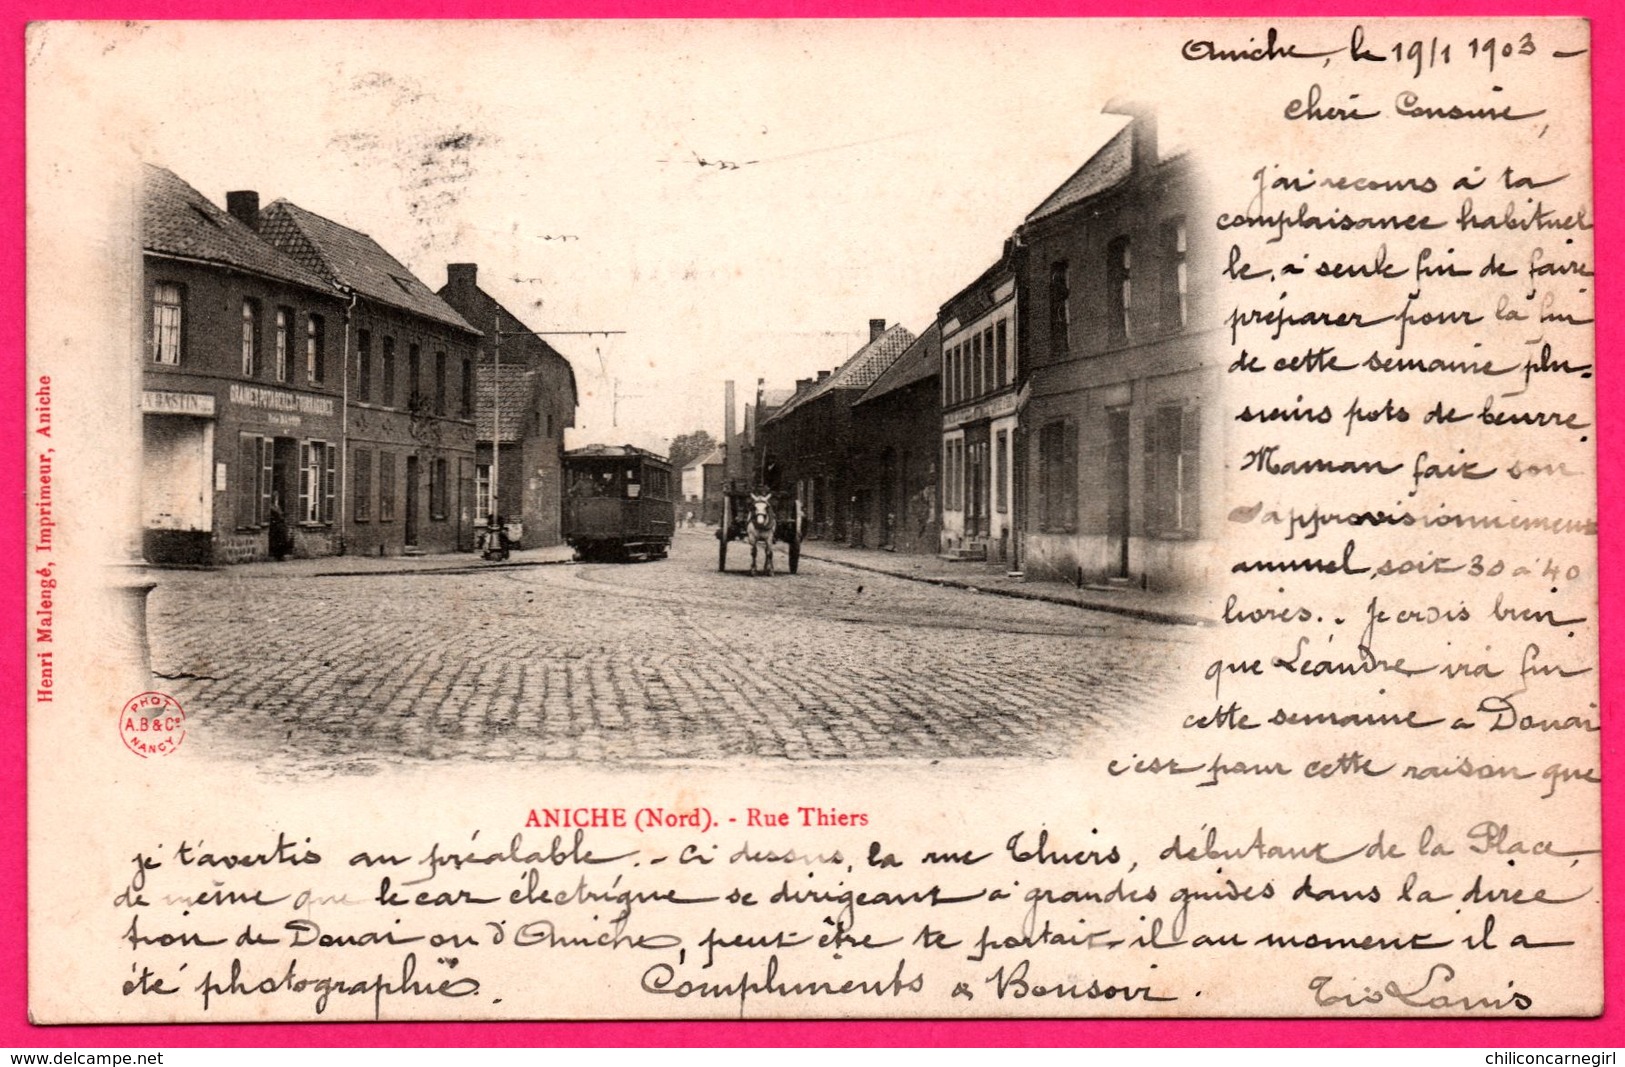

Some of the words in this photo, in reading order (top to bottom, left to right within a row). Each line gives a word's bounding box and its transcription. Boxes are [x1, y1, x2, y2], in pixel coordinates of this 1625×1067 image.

[1351, 25, 1386, 61] le
[1393, 36, 1449, 78] 19/1
[1470, 33, 1536, 72] 1903
[1320, 174, 1437, 193] recours
[1503, 167, 1571, 191] ta
[1216, 202, 1448, 244] complaisance
[1315, 243, 1409, 279] seule
[1479, 253, 1518, 277] de
[1528, 239, 1594, 299] faire
[1395, 295, 1484, 350] pour
[1495, 294, 1528, 322] la
[1227, 349, 1265, 374] de
[1273, 346, 1359, 373] cette
[1362, 343, 1520, 376] semaine
[36, 375, 52, 437] Aniche
[1346, 396, 1410, 436] pots
[1423, 400, 1473, 424] de
[1240, 444, 1404, 476] Maman
[1412, 449, 1497, 496] fait
[1505, 456, 1584, 480] son
[36, 448, 56, 553] Imprimeur,
[1377, 550, 1467, 577] soit
[1467, 554, 1505, 578] 30
[1541, 558, 1581, 581] 40
[36, 561, 57, 643] Malengé,
[1398, 601, 1471, 624] crois
[37, 652, 53, 703] Henri
[1205, 656, 1264, 700] que
[1182, 702, 1261, 732] cette
[1267, 691, 1446, 732] semaine
[131, 736, 174, 753] NANCY
[1196, 752, 1293, 788] pour
[1304, 750, 1396, 778] cette
[1402, 755, 1537, 781] raison
[1541, 760, 1601, 799] que
[525, 808, 627, 828] ANICHE
[634, 807, 719, 833] (Nord).
[747, 808, 790, 828] Rue
[798, 807, 869, 828] Thiers
[349, 851, 412, 867] au
[867, 841, 904, 868] la
[922, 851, 993, 866] rue
[1365, 829, 1406, 859] de
[1418, 825, 1454, 856] la
[113, 885, 150, 908] de
[375, 877, 409, 906] le
[415, 890, 501, 906] car
[725, 887, 758, 906] se
[1022, 878, 1158, 938] grandes
[1169, 866, 1274, 942] guides
[1292, 874, 1381, 903] dans
[1397, 872, 1453, 903] la
[235, 925, 280, 946] de
[284, 918, 425, 948] Douai
[912, 924, 963, 949] te
[1191, 935, 1247, 949] au
[1254, 932, 1452, 949] moment
[1456, 908, 1496, 950] il
[1510, 933, 1575, 949] a
